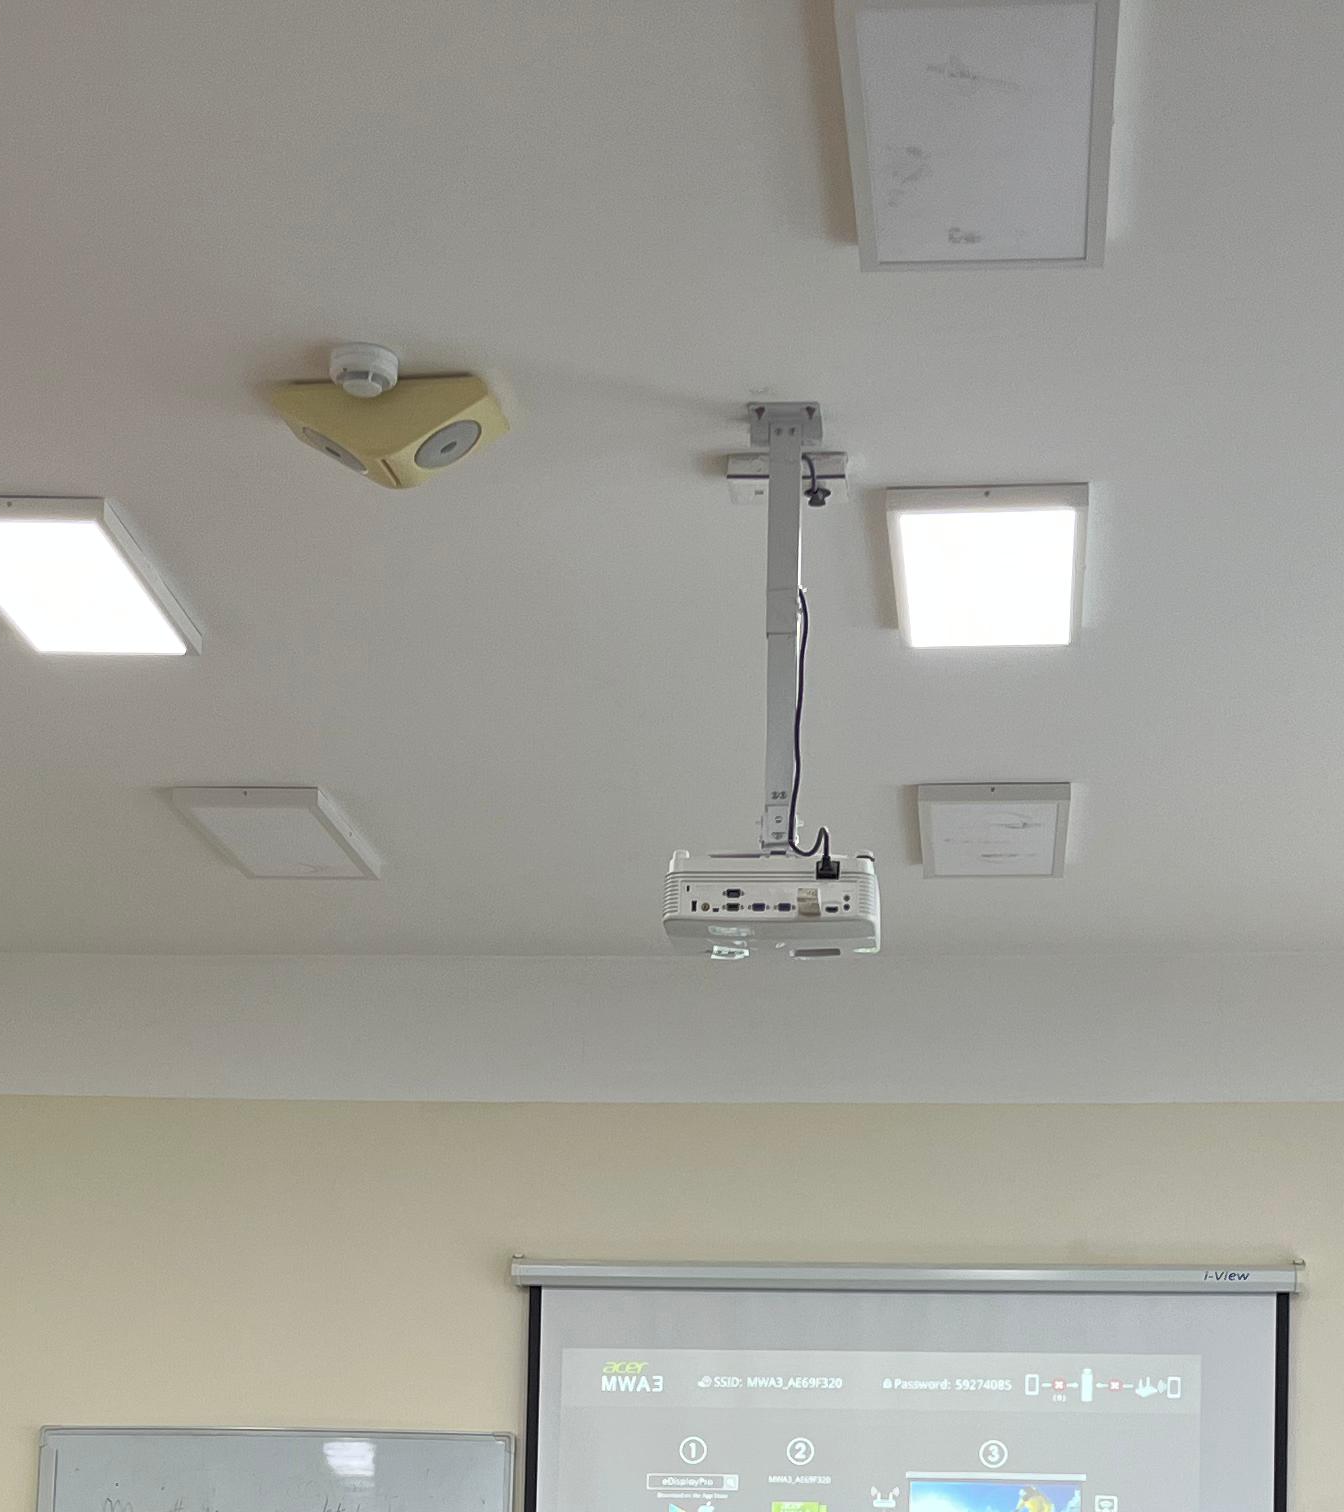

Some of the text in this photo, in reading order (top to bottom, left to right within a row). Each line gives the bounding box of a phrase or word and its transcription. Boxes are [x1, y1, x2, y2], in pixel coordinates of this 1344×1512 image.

[603, 1360, 648, 1374] acer
[601, 1375, 664, 1393] MWA3
[713, 1376, 844, 1391] SSID: MWA3_AE69F320
[894, 1378, 1013, 1392] Password: 59274085
